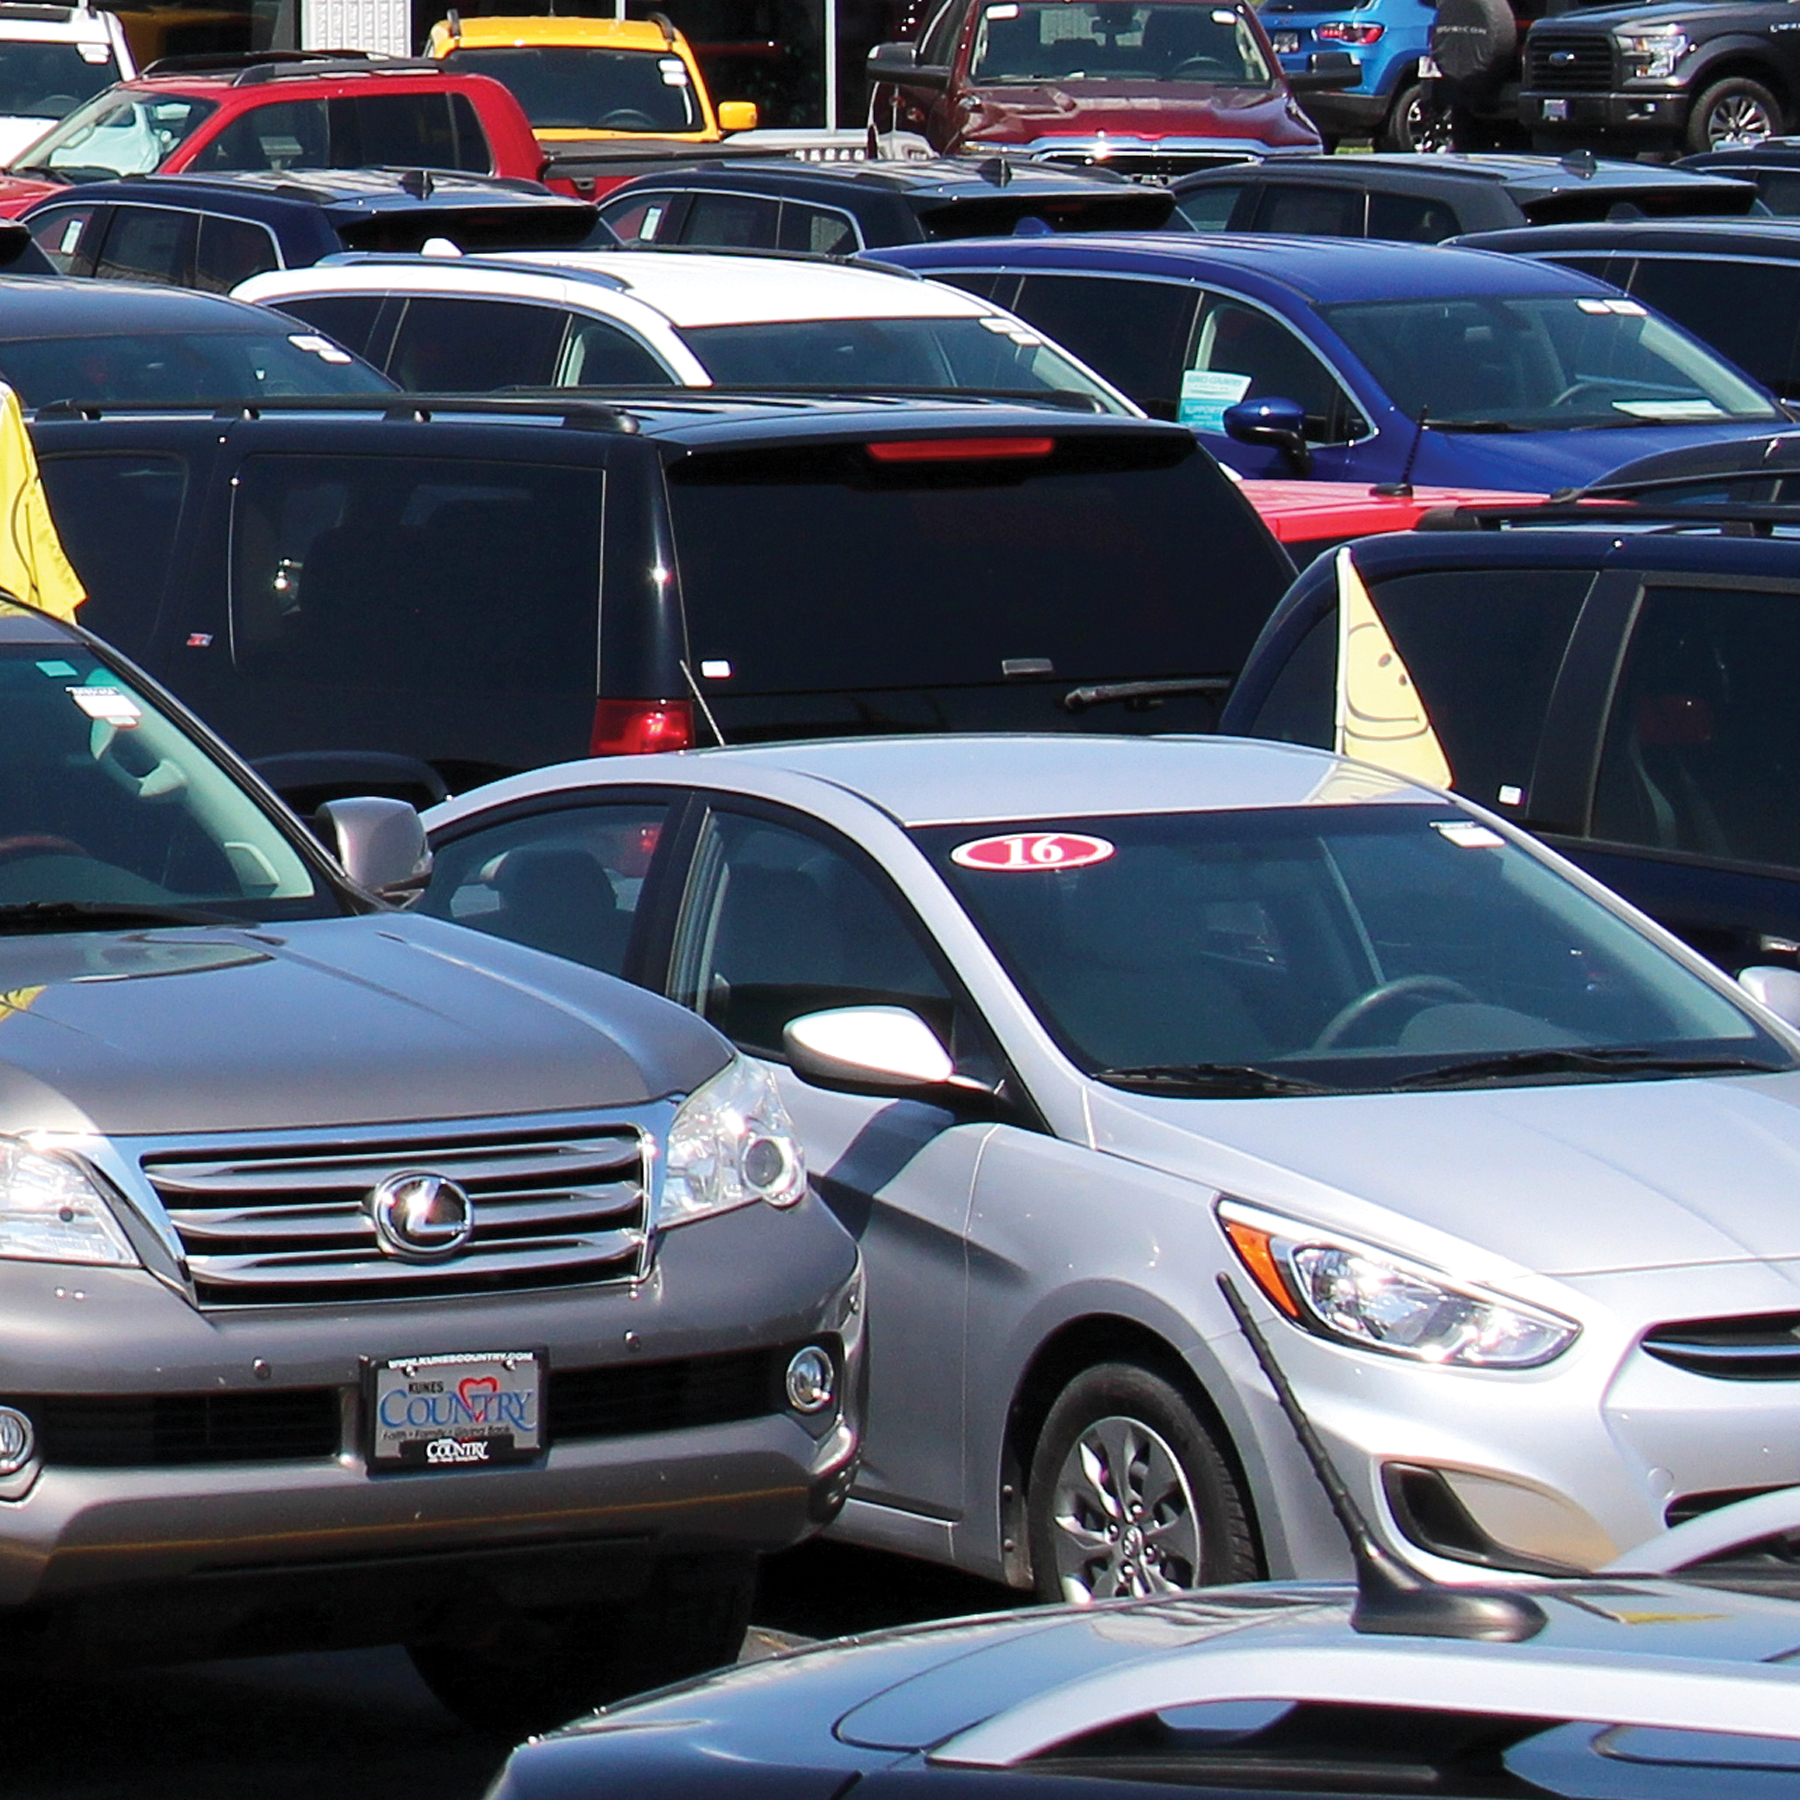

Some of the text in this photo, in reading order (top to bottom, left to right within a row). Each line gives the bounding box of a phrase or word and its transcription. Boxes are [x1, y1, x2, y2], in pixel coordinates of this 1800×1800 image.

[1002, 835, 1064, 866] 16
[408, 1381, 445, 1393] KUNES
[379, 1389, 538, 1432] COUNTRY
[426, 1440, 489, 1460] COUNTRY
